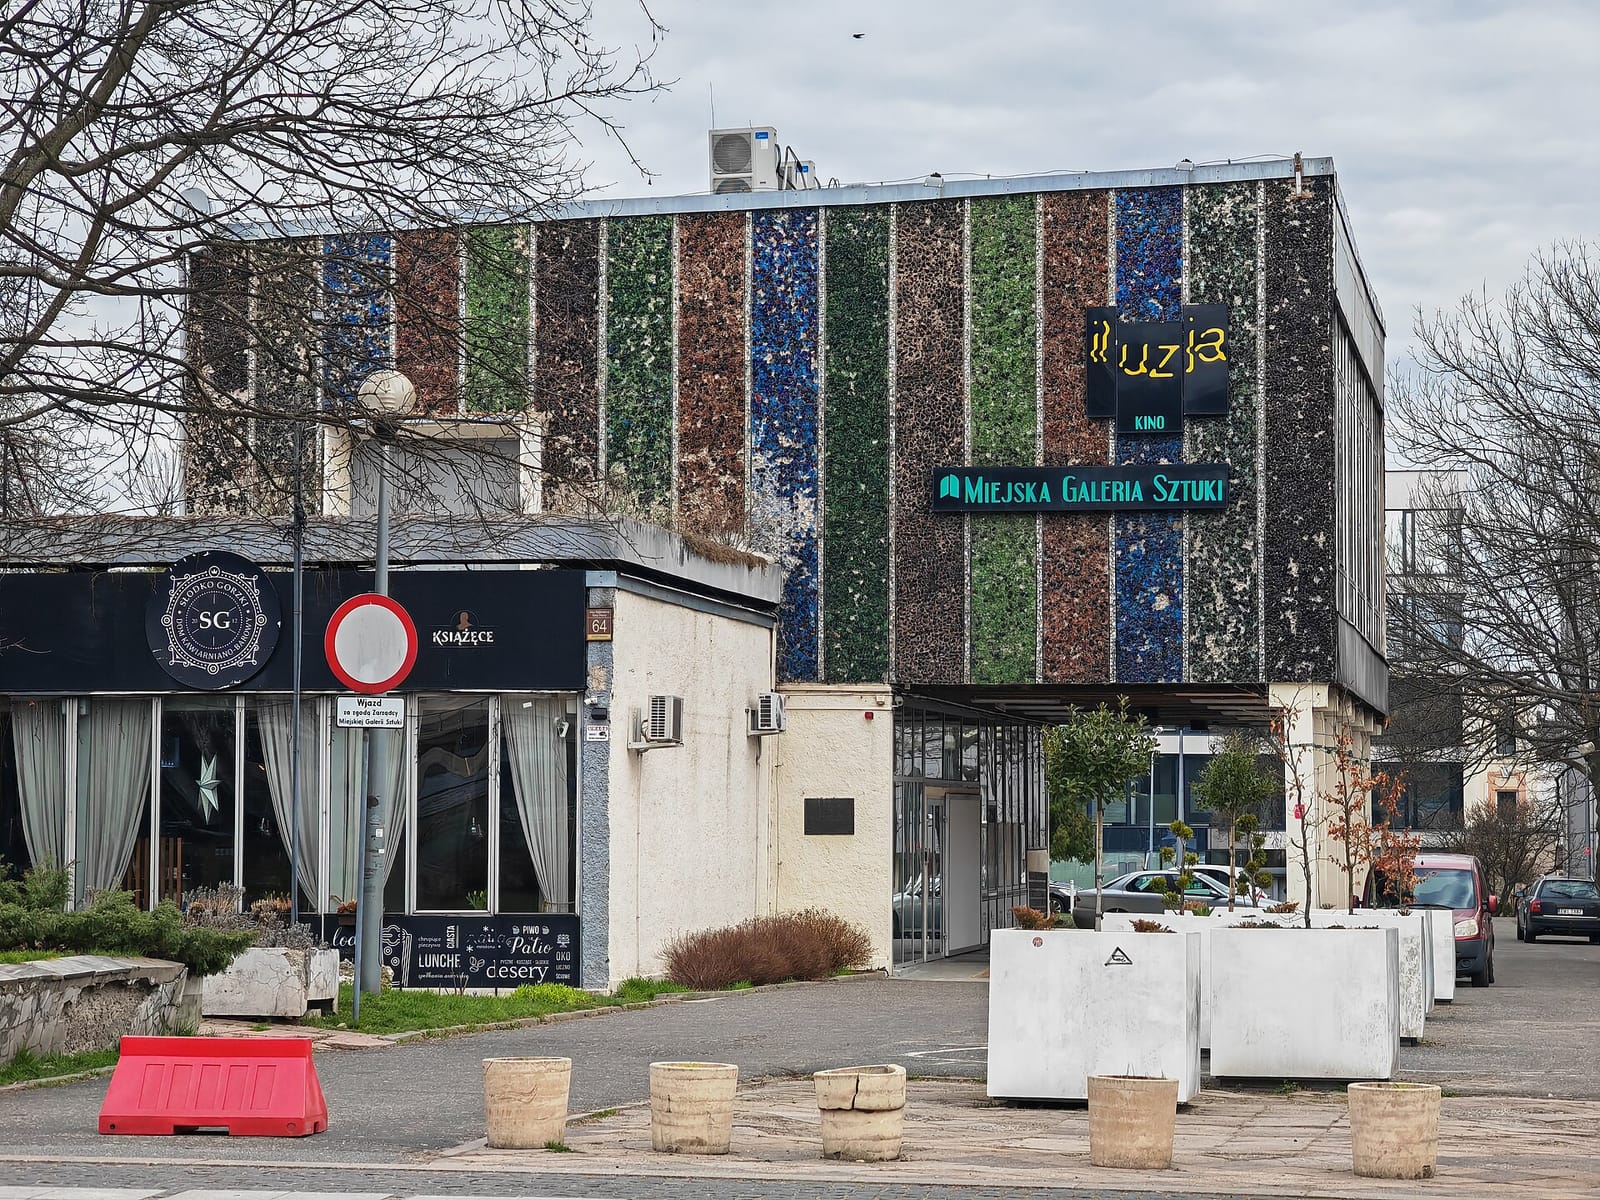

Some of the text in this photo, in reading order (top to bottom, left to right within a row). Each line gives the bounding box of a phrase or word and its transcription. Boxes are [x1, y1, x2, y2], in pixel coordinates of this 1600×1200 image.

[1090, 317, 1227, 378] iluzja
[1135, 415, 1165, 430] KINO
[964, 474, 1223, 504] MIEJSKA GALERIA SZTUKI
[216, 581, 249, 607] GORZKI
[176, 618, 184, 637] DOM
[199, 611, 230, 629] SG
[592, 619, 607, 633] 64
[432, 628, 494, 646] KSIĄŻĘCE
[357, 699, 382, 708] Wjazd
[338, 718, 363, 726] Miejskiej
[523, 926, 540, 934] PIWO
[506, 936, 554, 954] Patio
[556, 951, 571, 961] OKO
[486, 959, 549, 983] desery
